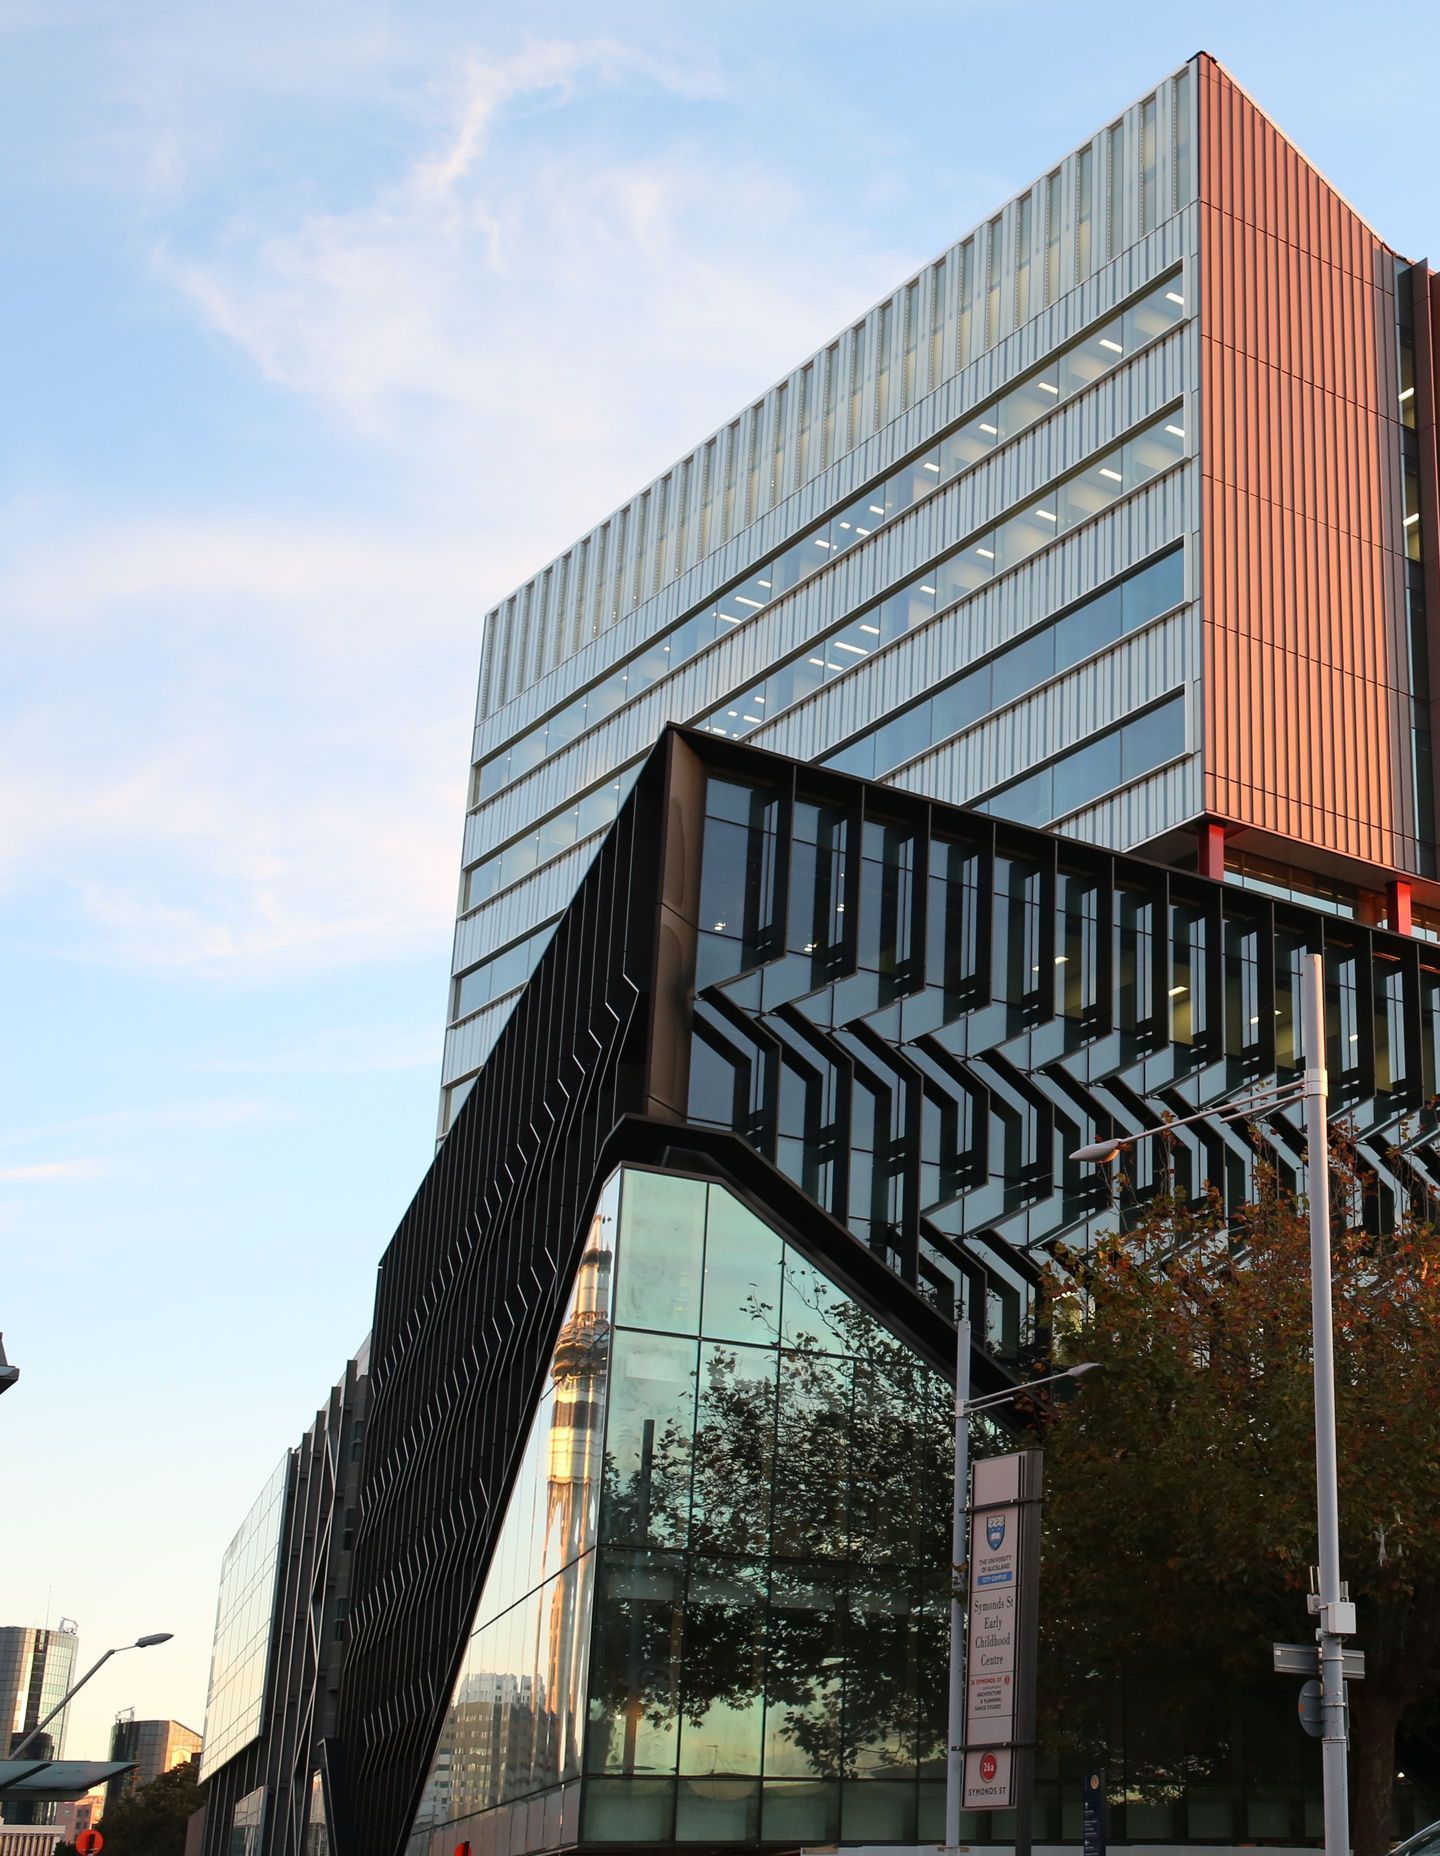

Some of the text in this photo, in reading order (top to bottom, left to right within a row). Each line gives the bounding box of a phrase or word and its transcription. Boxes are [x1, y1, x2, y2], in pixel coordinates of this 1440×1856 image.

[988, 1555, 1012, 1564] UNIVERSITY
[988, 1563, 1011, 1572] AUCKLAND
[974, 1595, 1014, 1615] Symonds St
[984, 1615, 1003, 1630] Early
[975, 1632, 1011, 1648] Childhood
[981, 1654, 1004, 1666] Centre
[983, 1762, 994, 1772] 26a
[968, 1786, 1006, 1797] SYMONDS ST
